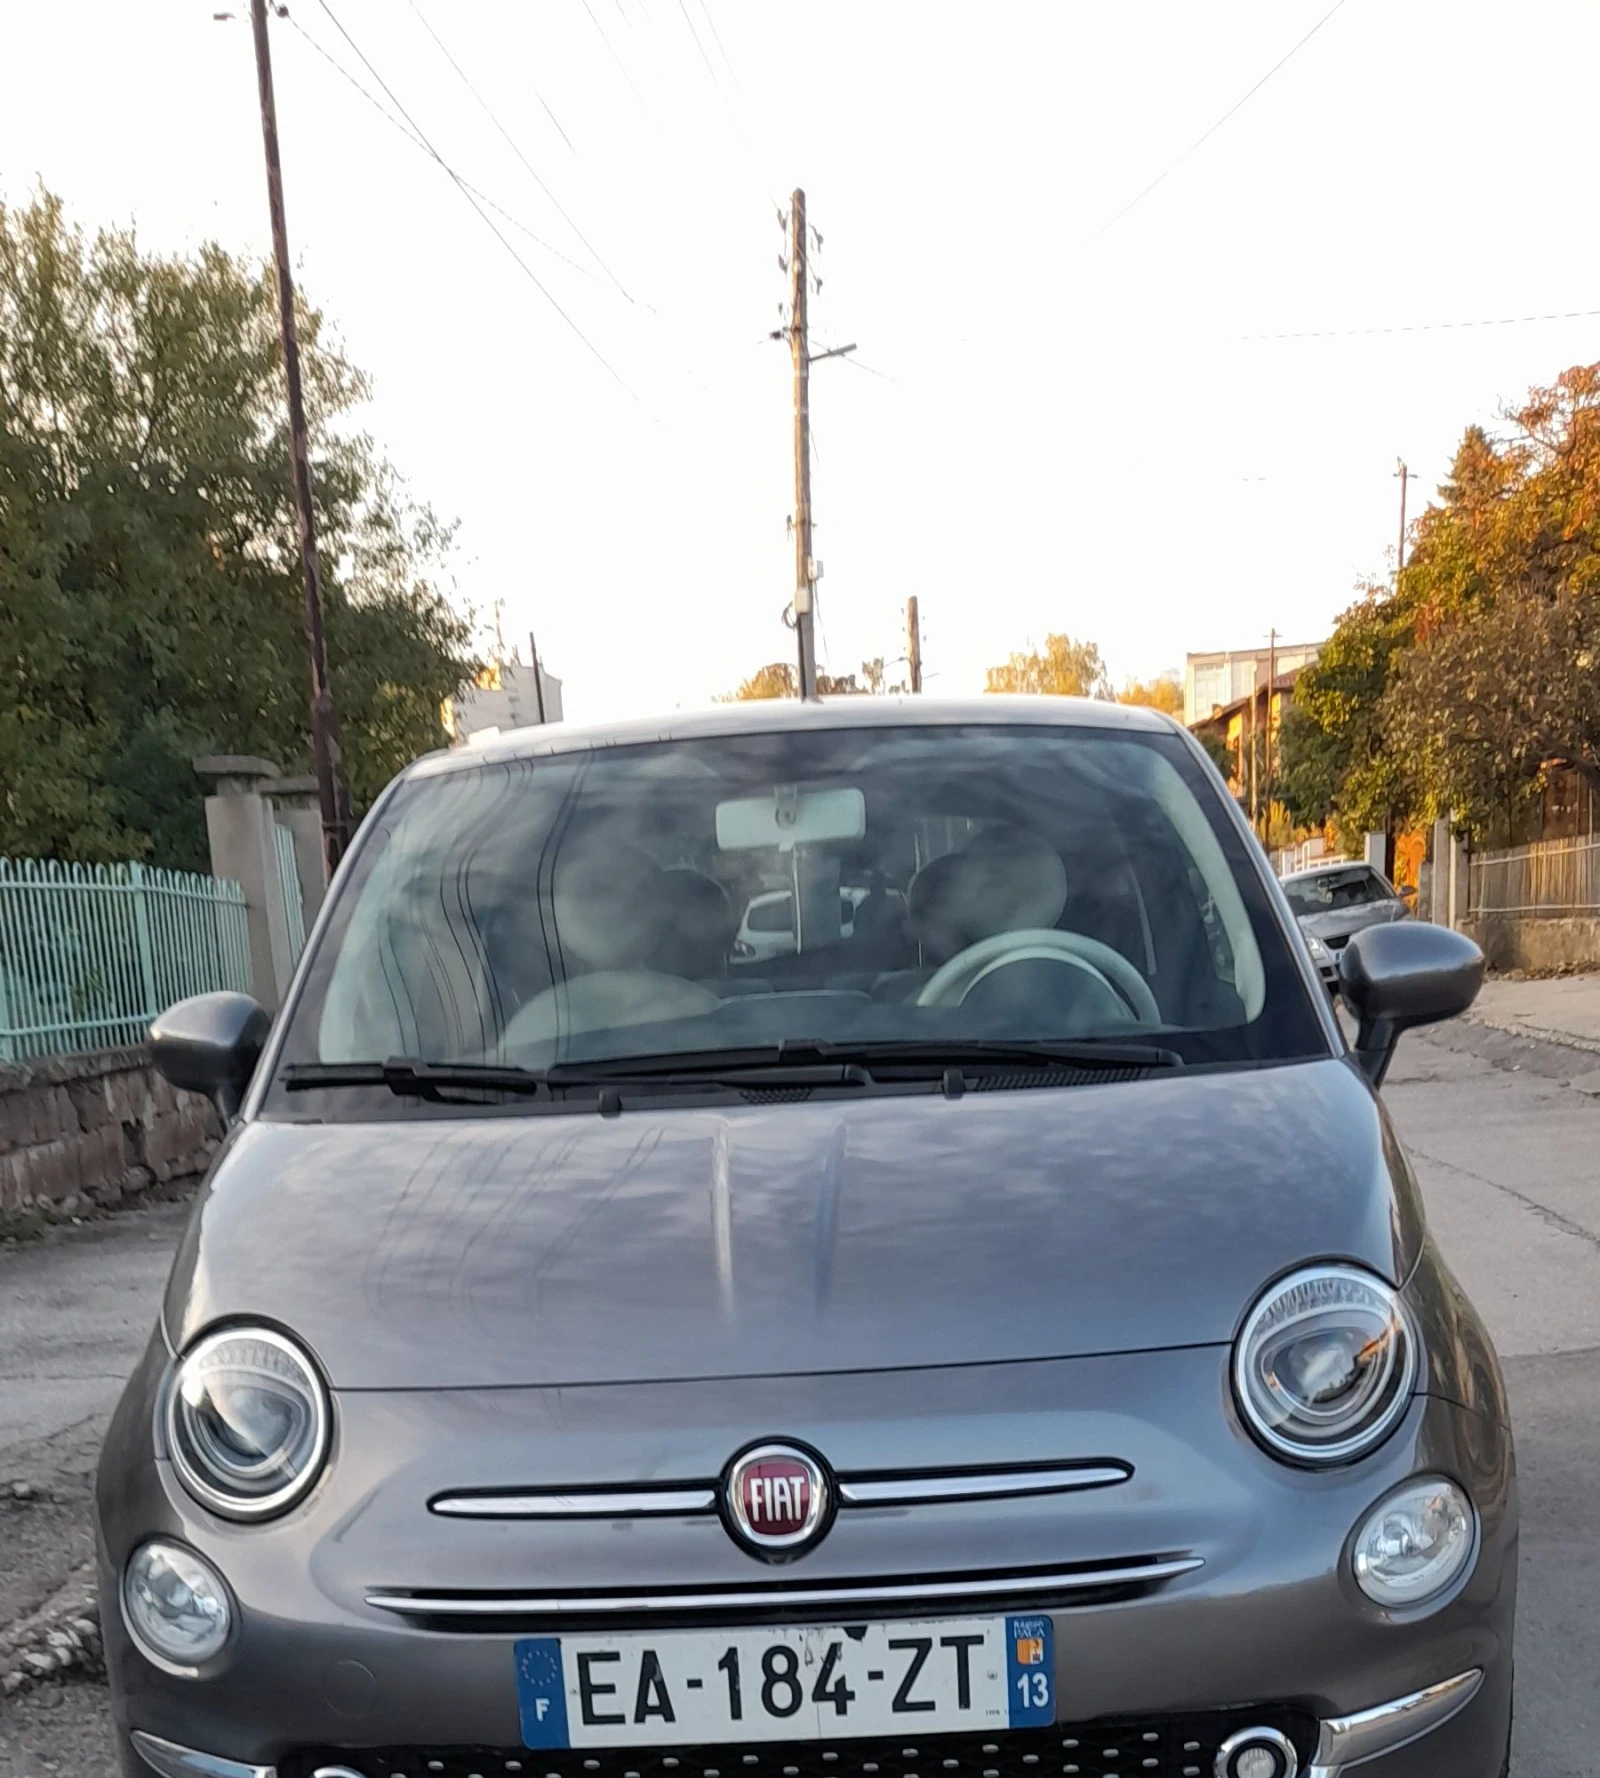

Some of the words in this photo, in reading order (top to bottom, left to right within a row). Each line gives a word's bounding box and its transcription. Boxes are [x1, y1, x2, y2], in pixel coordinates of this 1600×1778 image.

[750, 1476, 805, 1522] FIAT
[577, 1636, 984, 1725] EA-184-ZT
[1017, 1672, 1049, 1707] 13
[537, 1699, 551, 1721] F
